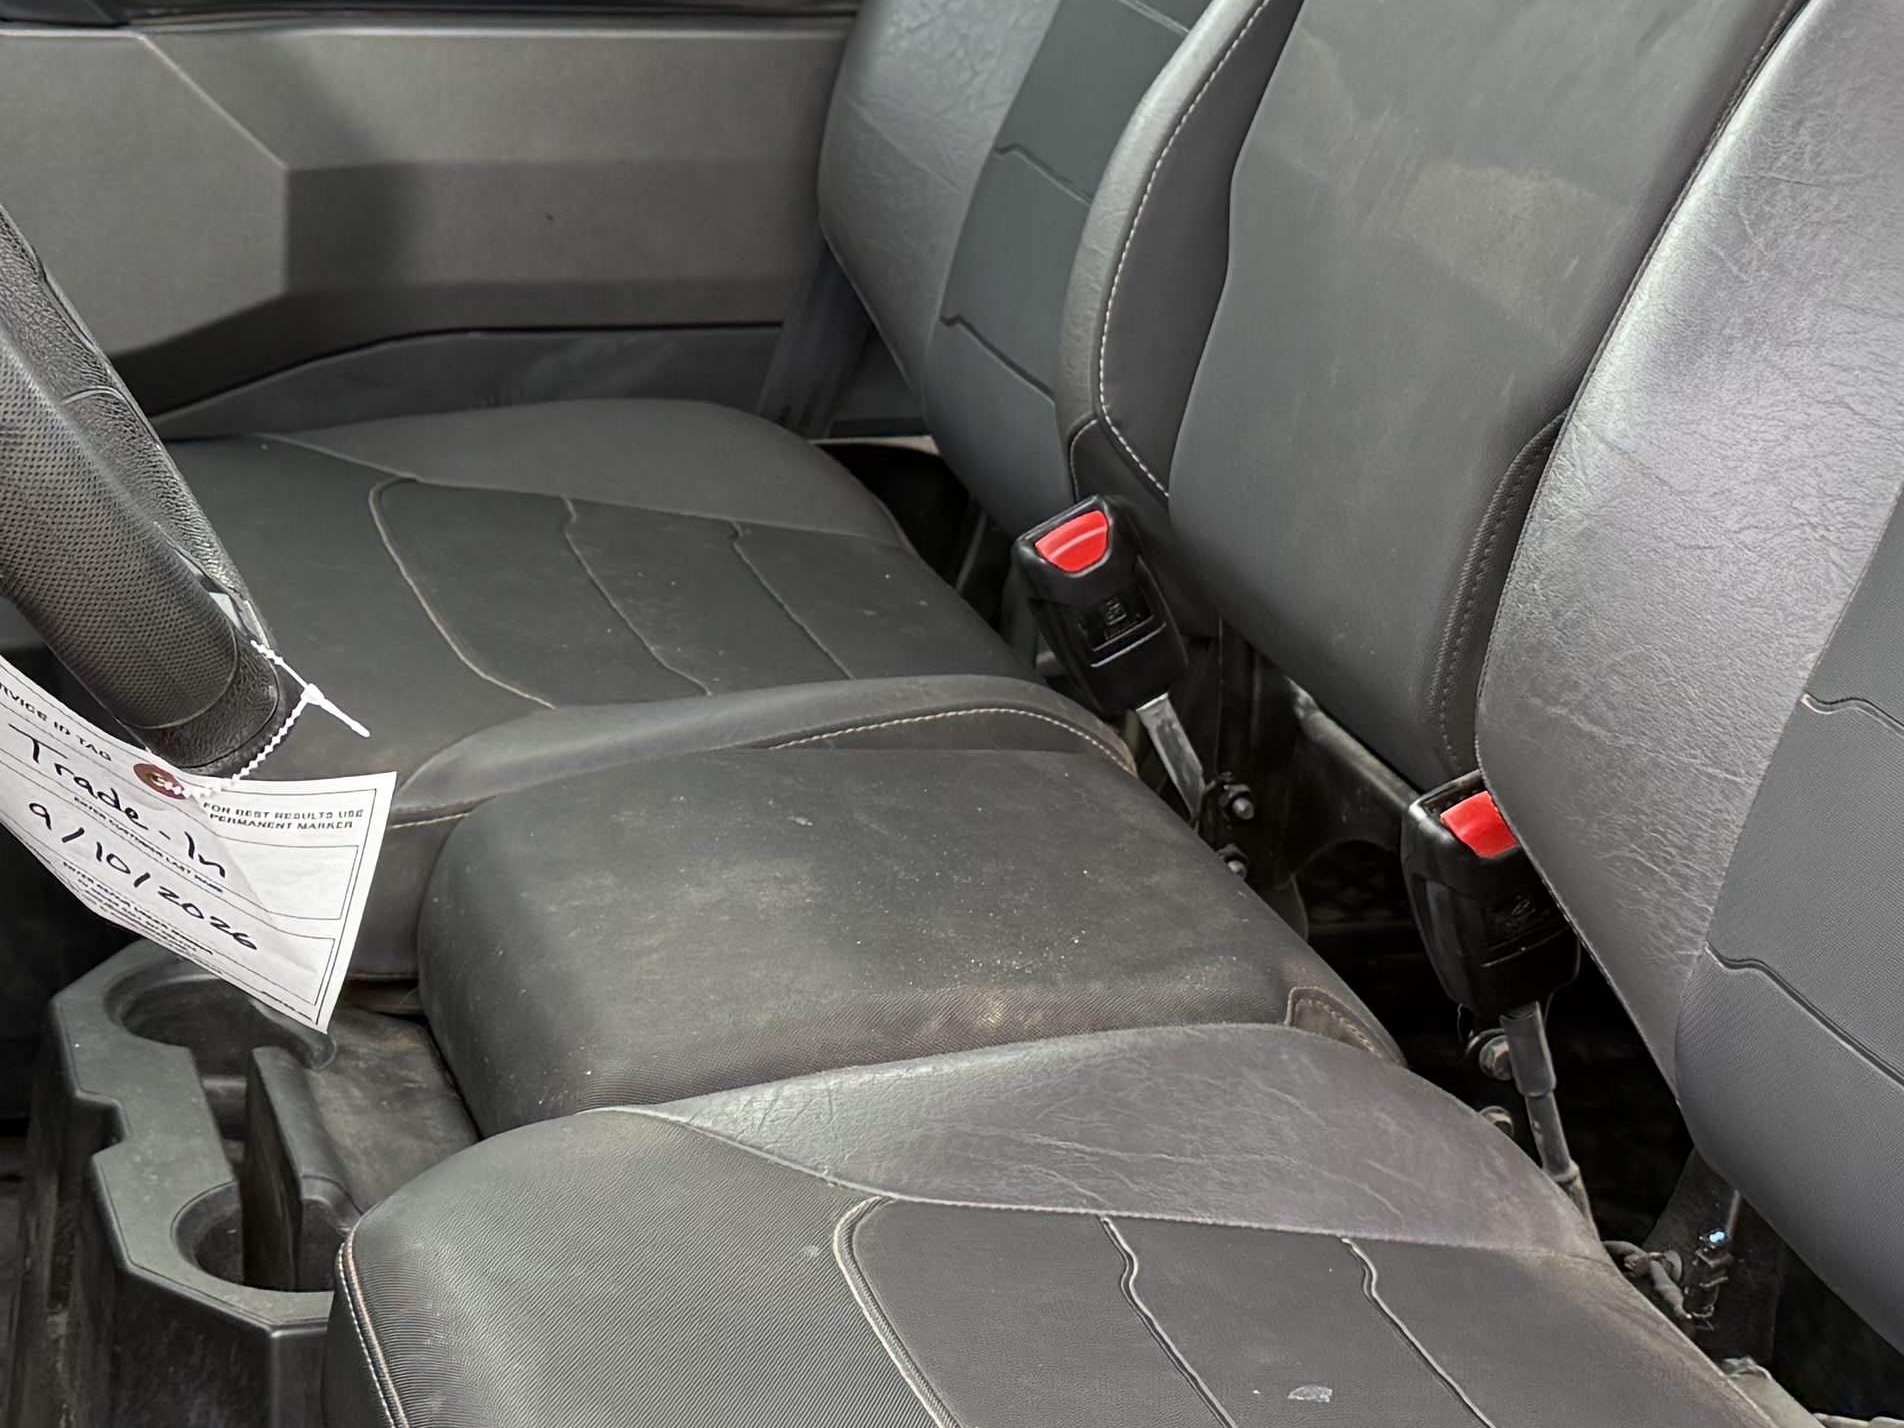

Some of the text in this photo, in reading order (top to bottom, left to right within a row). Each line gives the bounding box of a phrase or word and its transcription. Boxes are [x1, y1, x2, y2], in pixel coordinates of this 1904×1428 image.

[54, 721, 72, 736] ID
[76, 737, 112, 761] TAG
[203, 802, 364, 820] FOR BEST RESULTS USE
[209, 813, 353, 829] PERMANENT MARKER
